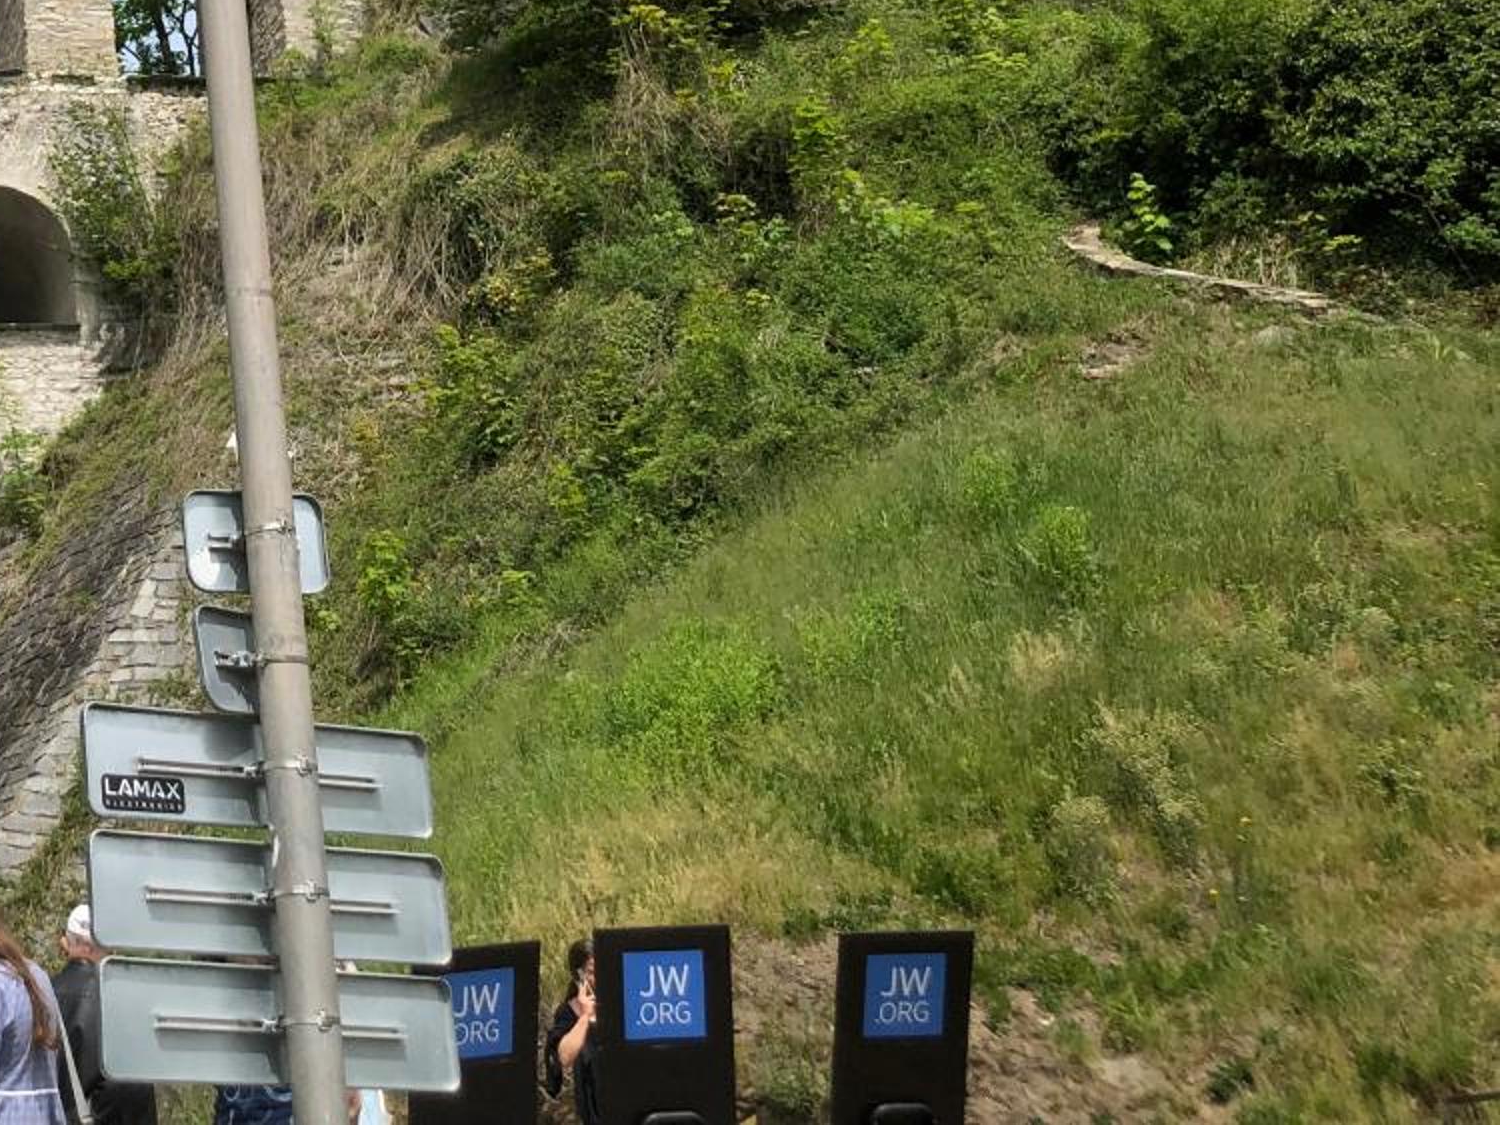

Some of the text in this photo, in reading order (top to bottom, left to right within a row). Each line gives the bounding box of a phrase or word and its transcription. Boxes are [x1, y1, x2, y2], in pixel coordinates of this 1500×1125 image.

[104, 777, 181, 800] LAMAX
[640, 963, 689, 997] JW
[880, 966, 931, 996] JW
[453, 982, 500, 1017] JW
[636, 1001, 692, 1025] .ORG
[874, 1001, 930, 1024] .ORG
[454, 1019, 500, 1046] ORG
